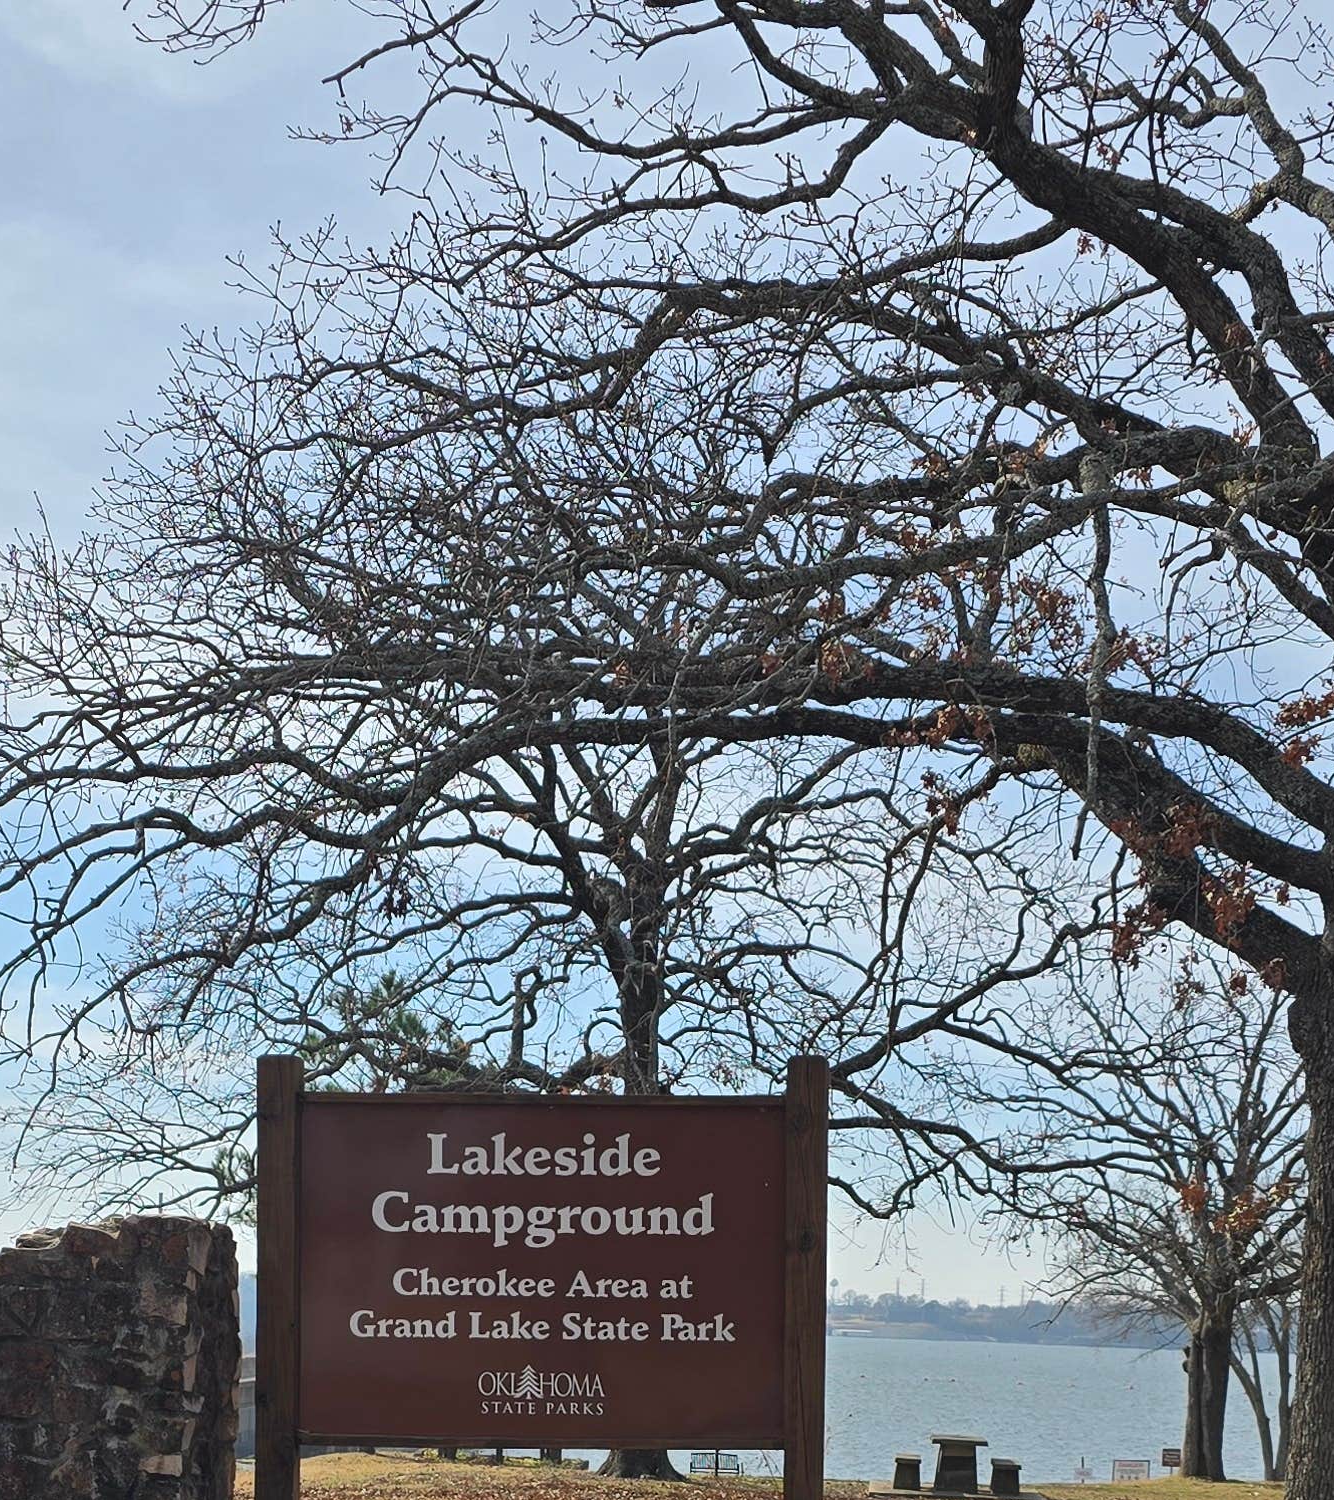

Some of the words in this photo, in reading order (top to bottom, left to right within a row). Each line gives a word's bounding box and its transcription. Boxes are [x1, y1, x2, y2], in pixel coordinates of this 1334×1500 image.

[426, 1132, 661, 1177] Lakeside
[371, 1190, 715, 1249] Campground
[392, 1267, 556, 1298] Cherokee
[565, 1270, 649, 1299] Area
[659, 1275, 693, 1299] at
[349, 1309, 458, 1339] Grand
[468, 1310, 550, 1340] Lake
[562, 1312, 650, 1341] State
[660, 1313, 736, 1342] Park
[478, 1365, 605, 1399] OKLAHOMA
[481, 1401, 536, 1415] STATE
[546, 1402, 604, 1416] PARKS
